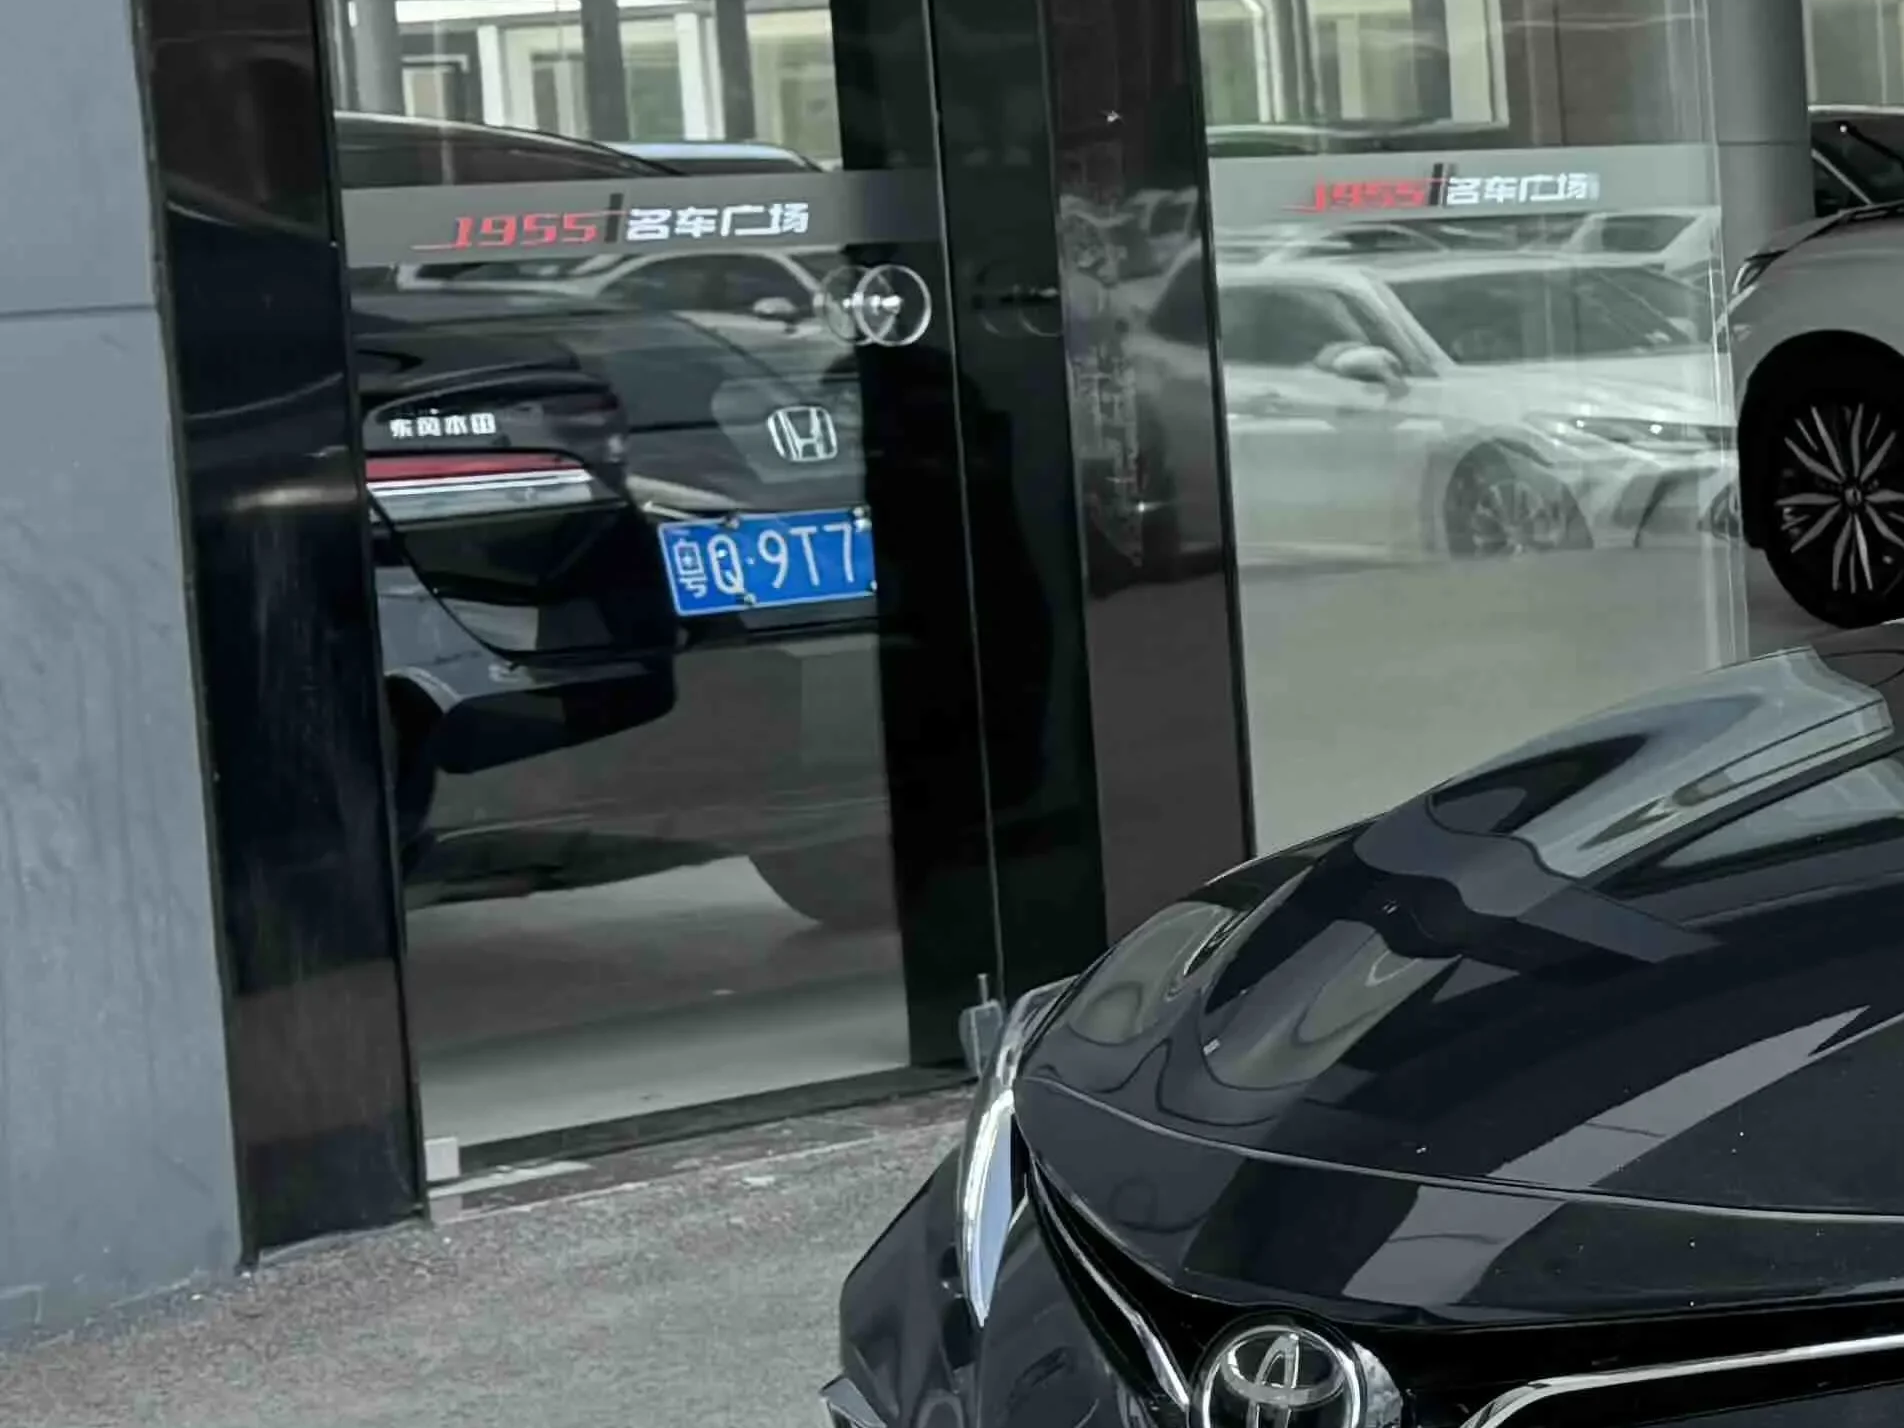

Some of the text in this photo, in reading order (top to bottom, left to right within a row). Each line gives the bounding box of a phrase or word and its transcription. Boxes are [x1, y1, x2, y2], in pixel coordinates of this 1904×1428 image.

[1303, 172, 1599, 214] 1955 名车广场
[440, 202, 810, 252] 1955 名车广场
[389, 410, 497, 440] 东风本田
